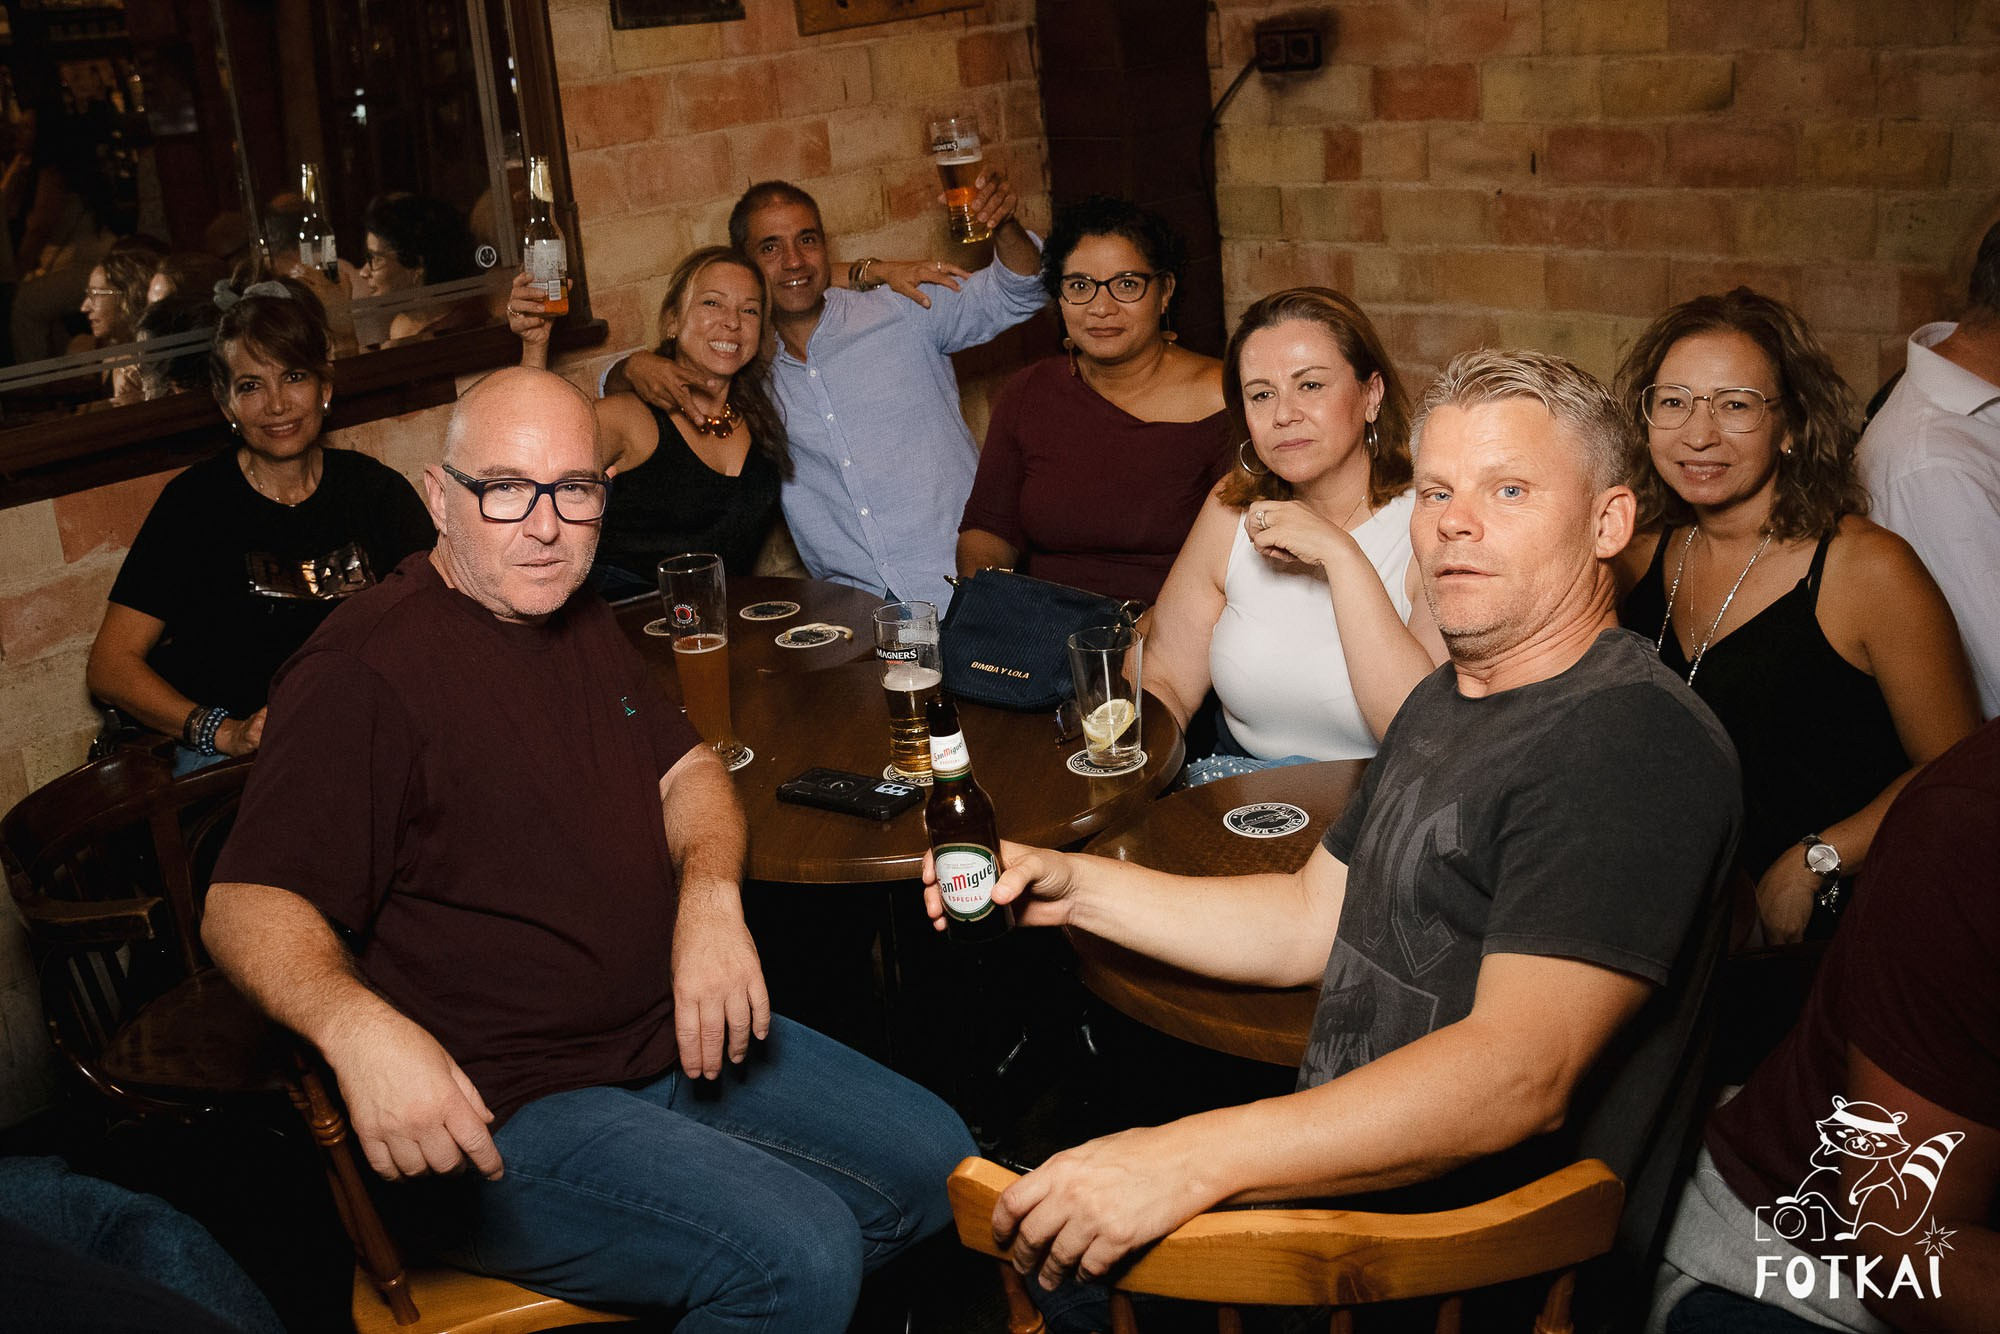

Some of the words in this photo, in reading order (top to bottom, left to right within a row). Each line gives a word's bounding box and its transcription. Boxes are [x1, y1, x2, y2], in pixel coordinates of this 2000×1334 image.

[876, 648, 917, 660] MAGNERS
[970, 661, 999, 673] BIMBA
[1007, 669, 1030, 679] LOLA
[937, 855, 997, 893] anMiguel
[948, 895, 983, 903] ESPECIAL
